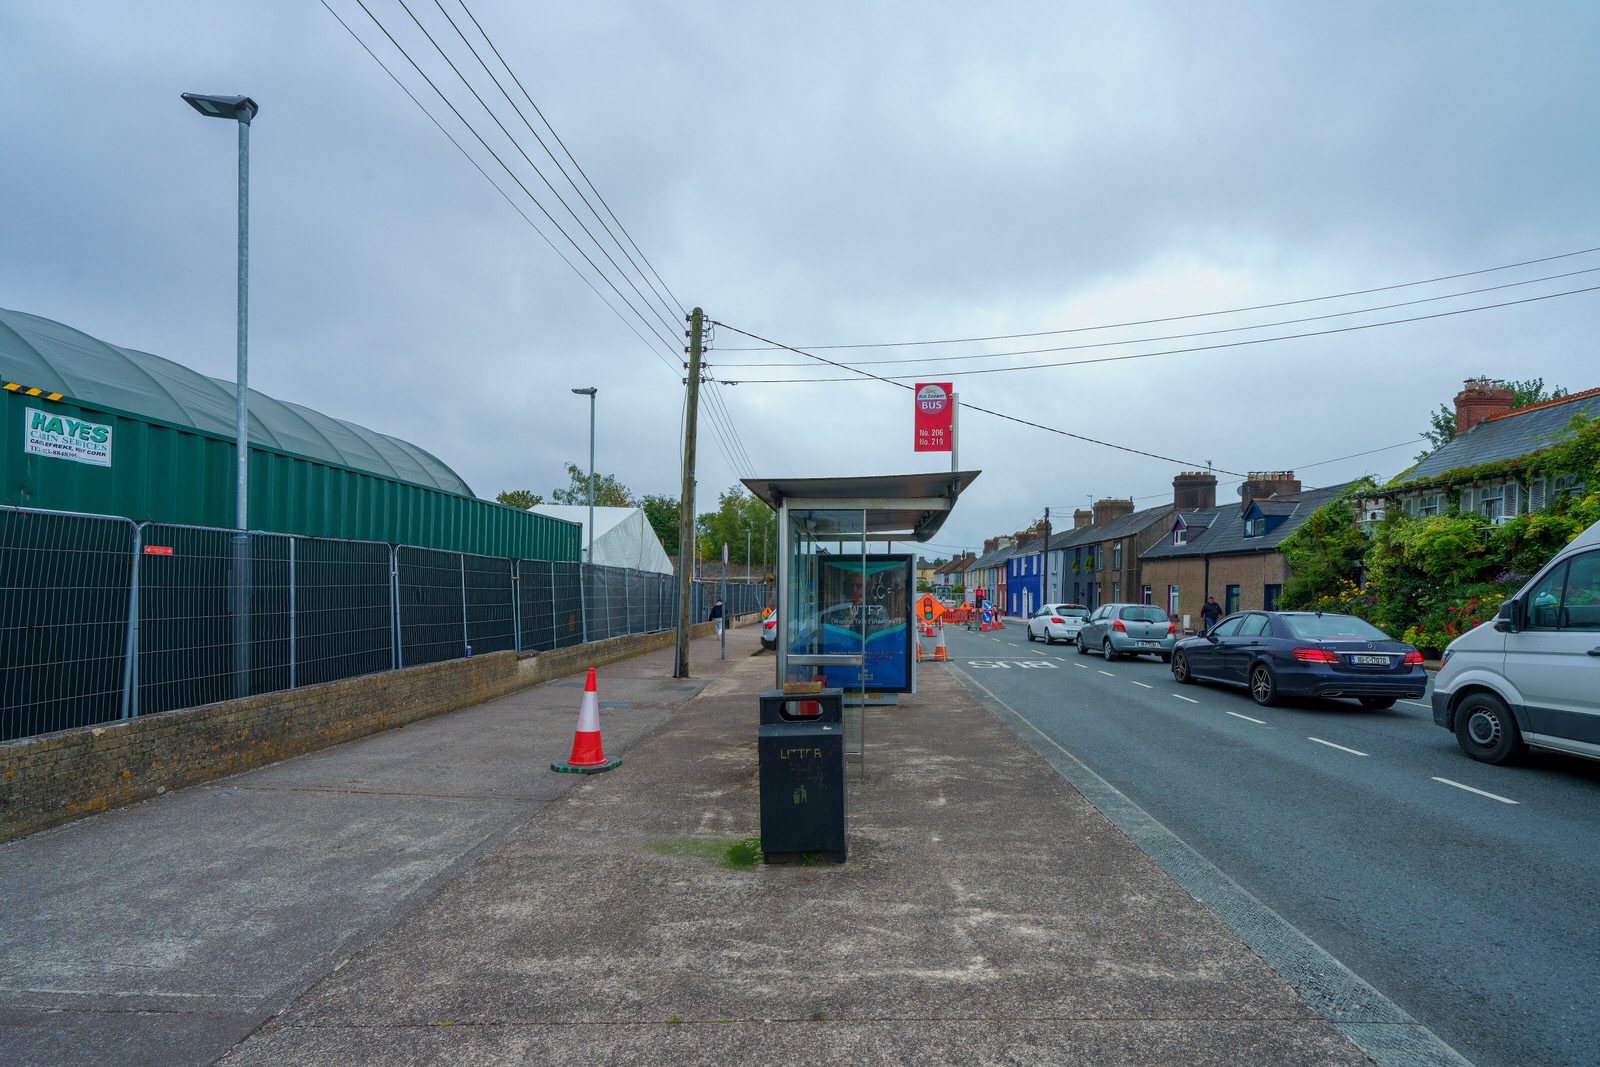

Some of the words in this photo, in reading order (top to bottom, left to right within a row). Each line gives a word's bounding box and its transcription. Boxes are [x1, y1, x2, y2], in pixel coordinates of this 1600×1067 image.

[921, 401, 942, 410] BUS
[31, 412, 109, 443] HAYES
[967, 661, 1059, 669] BUS
[781, 748, 822, 759] LITR
